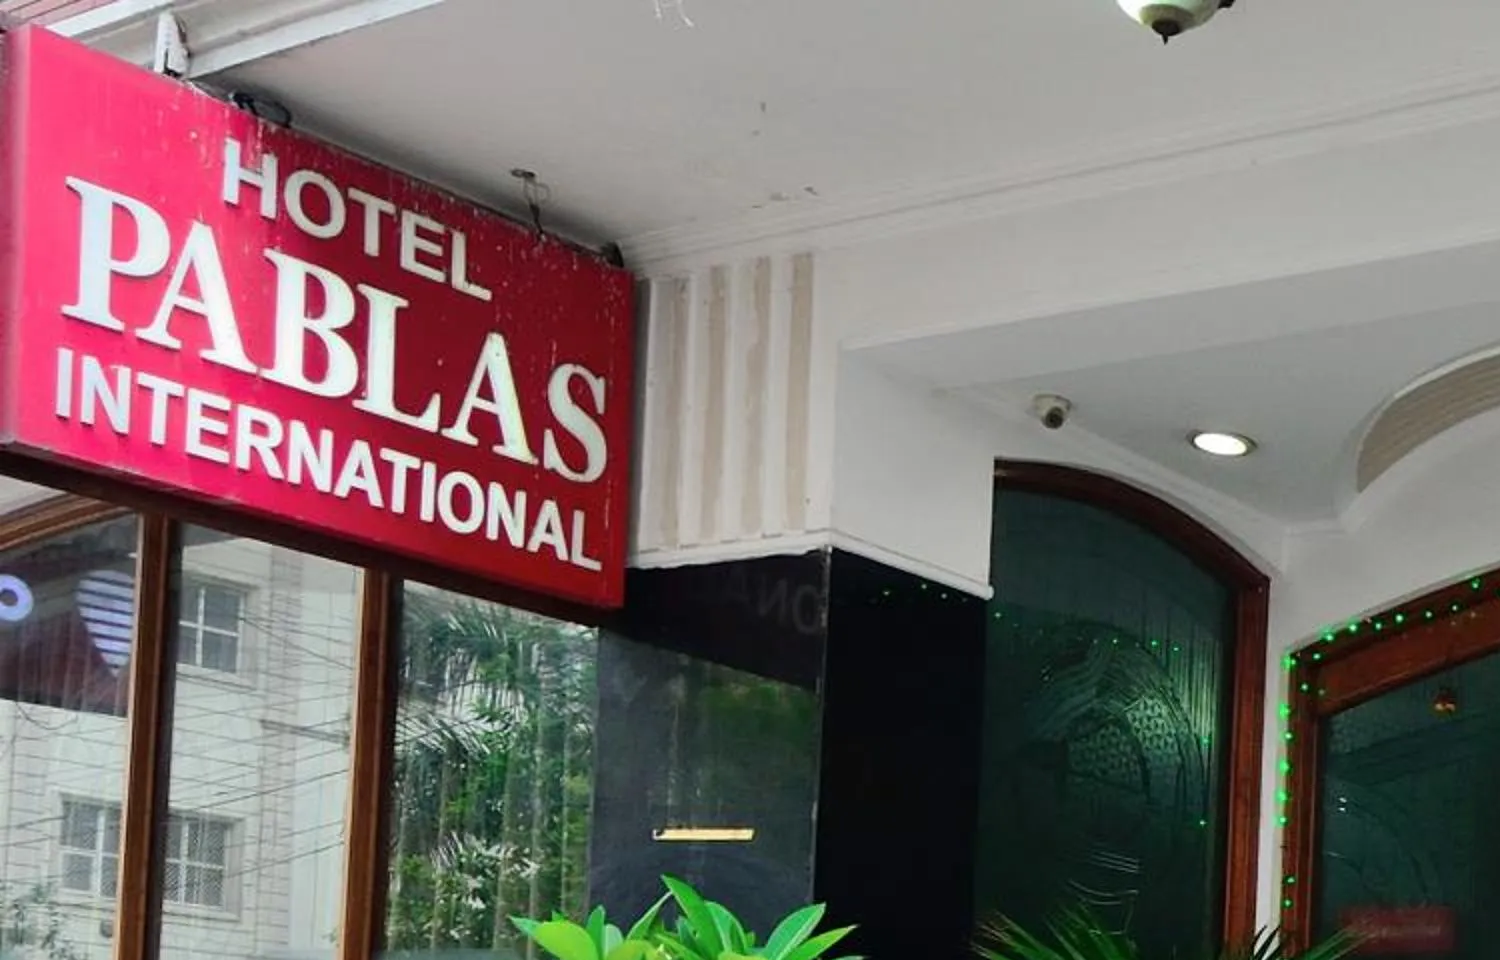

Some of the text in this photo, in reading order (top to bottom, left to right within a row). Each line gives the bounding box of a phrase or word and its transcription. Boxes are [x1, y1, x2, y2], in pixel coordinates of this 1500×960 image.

[61, 175, 608, 483] PABLAS
[224, 138, 492, 301] HOTEL
[56, 347, 602, 571] INTERNATIONAL
